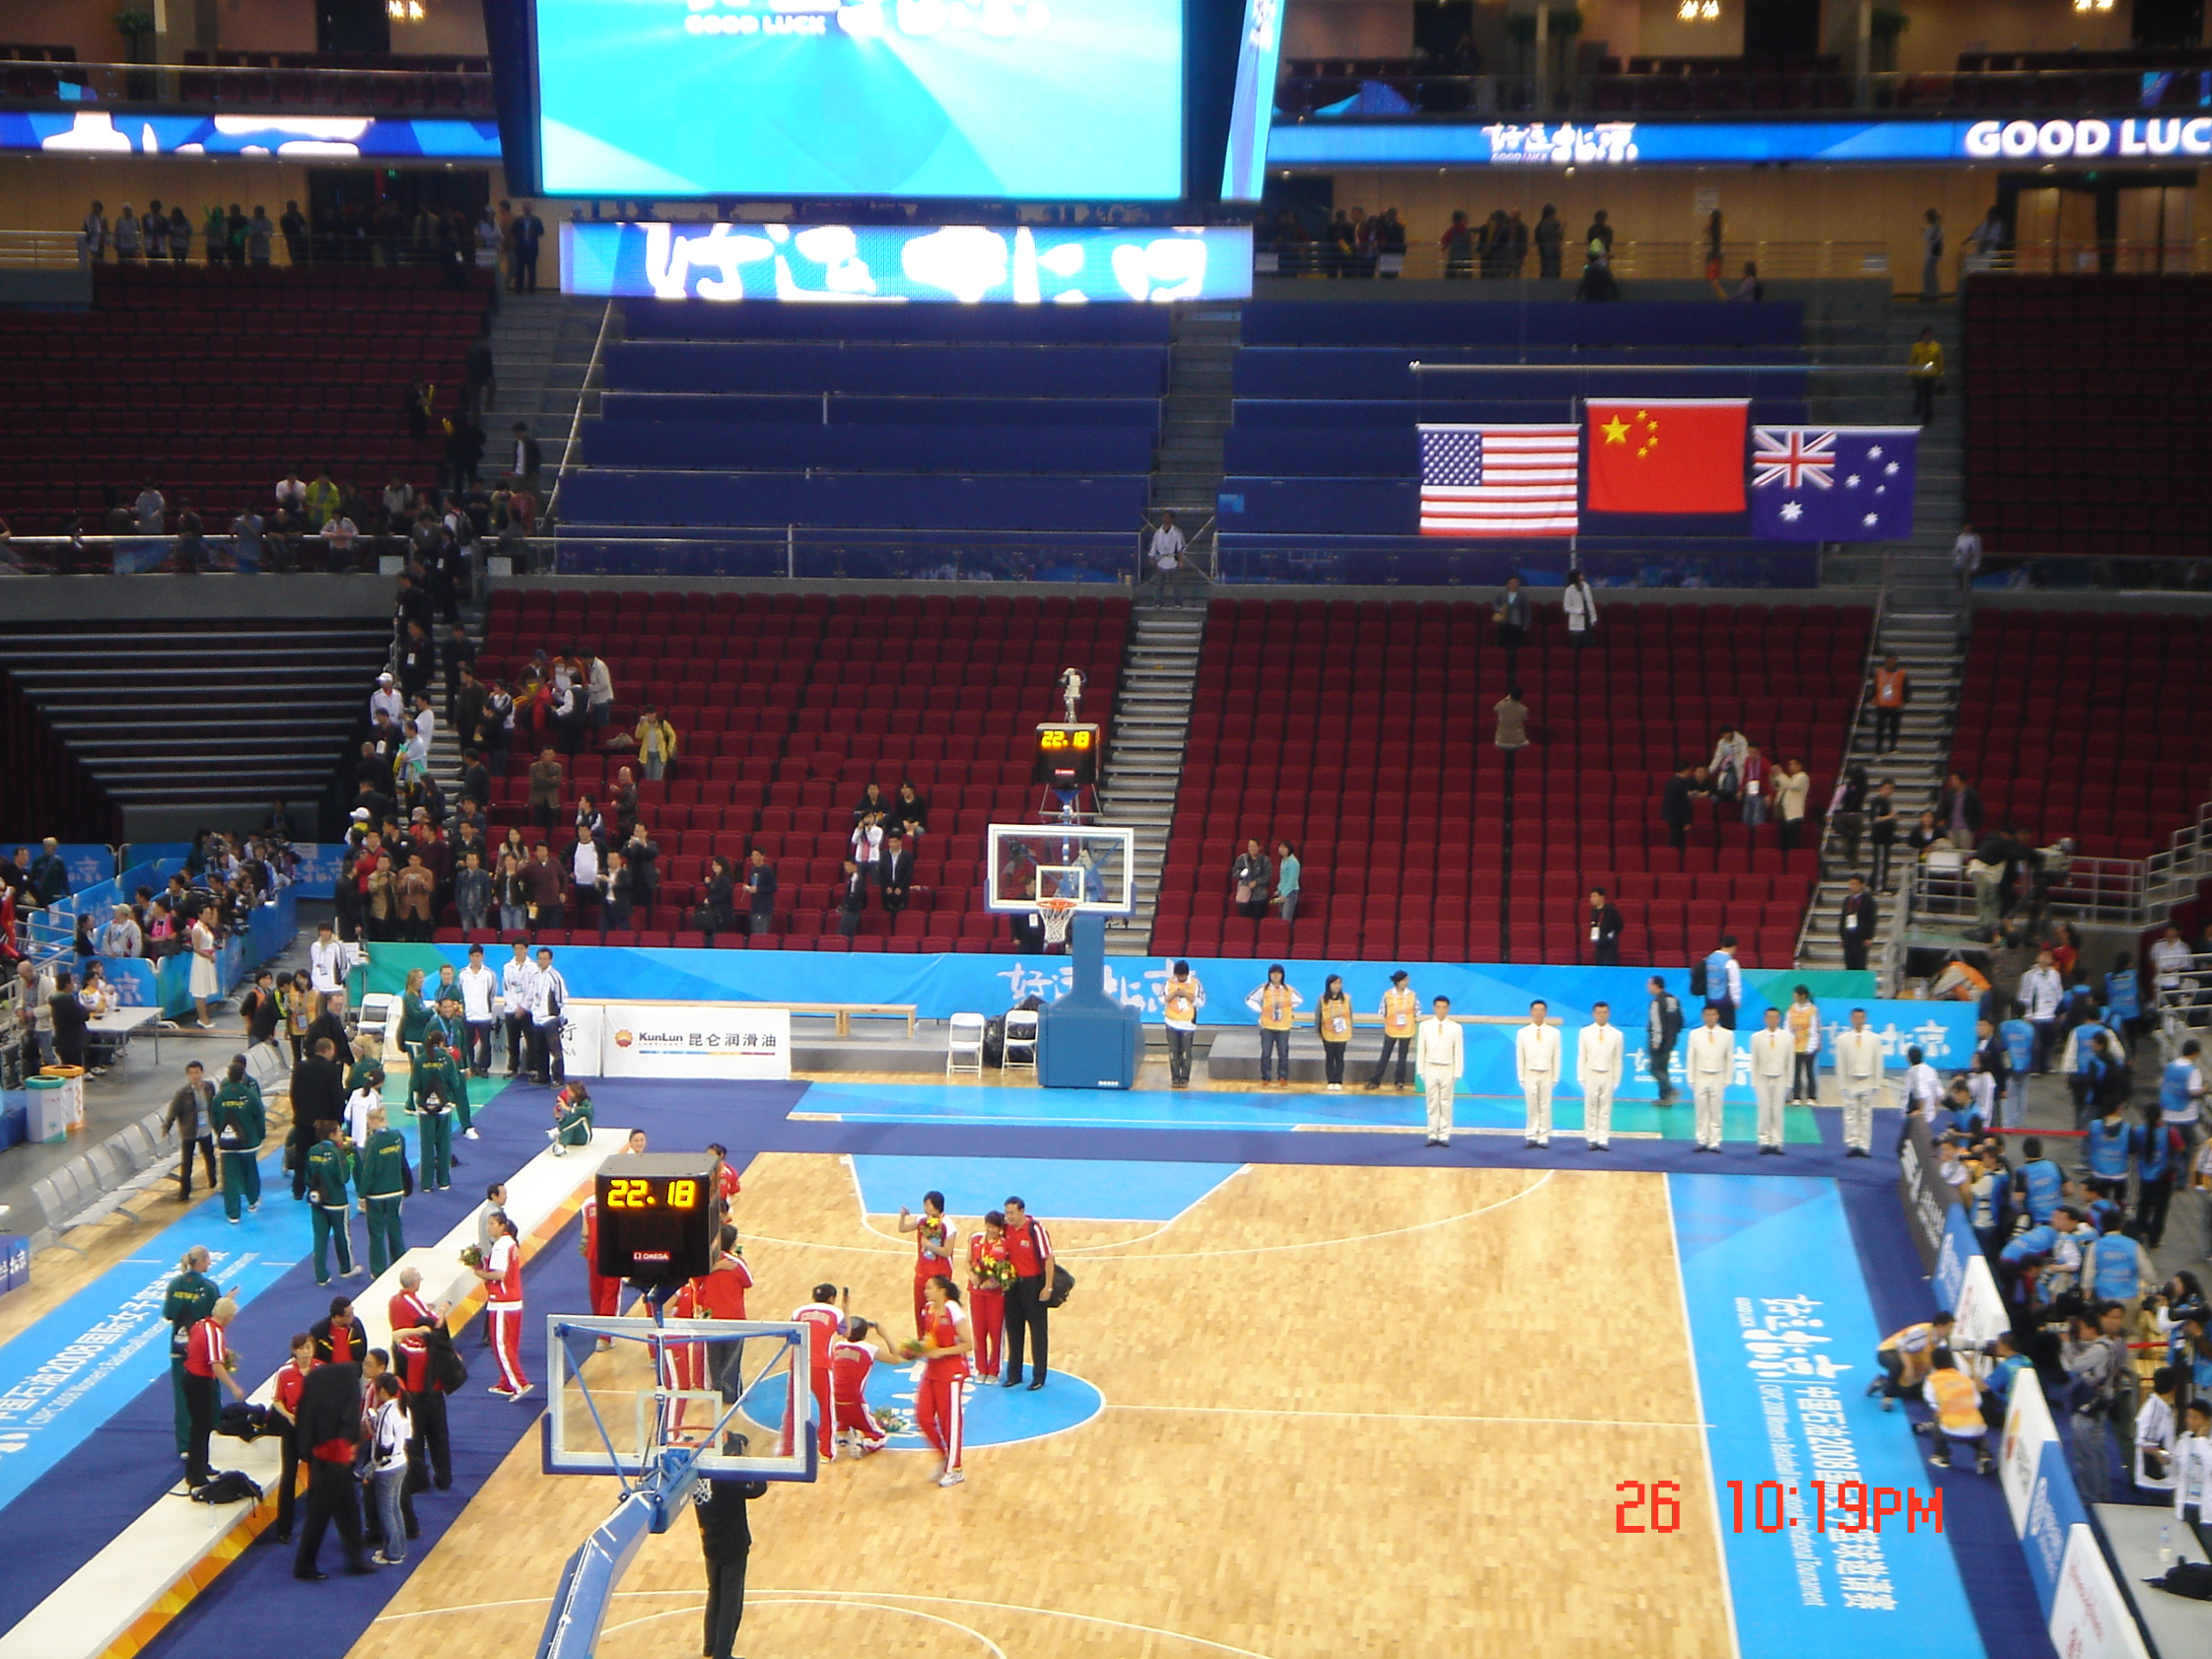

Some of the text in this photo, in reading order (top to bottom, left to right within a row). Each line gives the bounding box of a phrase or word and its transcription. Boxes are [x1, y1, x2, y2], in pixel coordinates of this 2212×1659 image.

[1965, 118, 2111, 157] GOOD
[639, 1032, 683, 1042] KunLun
[689, 1033, 777, 1047] 昆仑润滑油
